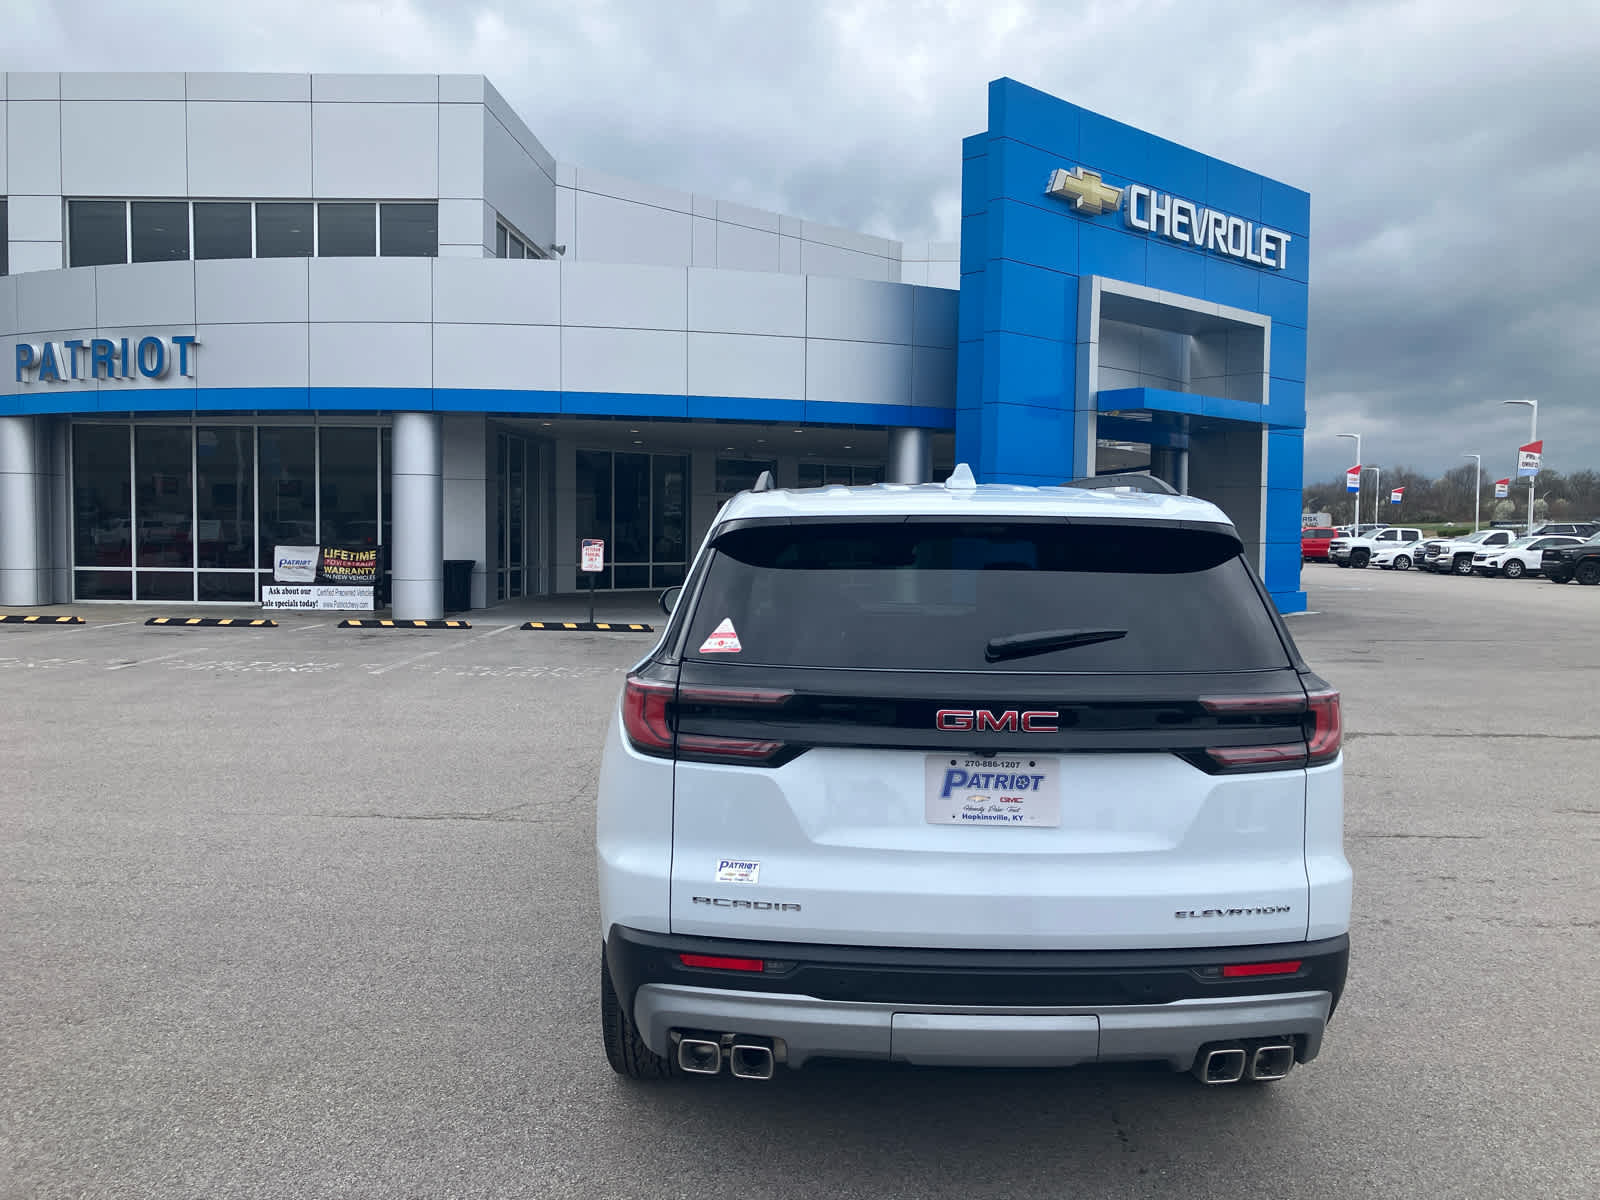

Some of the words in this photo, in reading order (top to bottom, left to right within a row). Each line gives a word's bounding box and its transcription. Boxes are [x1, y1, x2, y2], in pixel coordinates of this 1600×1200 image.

[1124, 184, 1292, 270] CHEVROLET
[16, 336, 201, 383] PATRIOT
[324, 548, 377, 561] LIFETIME
[279, 559, 312, 568] PATRIOT
[323, 566, 376, 575] WARRANTY
[269, 587, 281, 595] Ask
[282, 587, 299, 595] about
[275, 600, 298, 608] specials
[936, 709, 1060, 733] GMC
[964, 760, 1021, 769] 270-886-1207
[941, 768, 1045, 799] PATRIOT
[962, 813, 1011, 821] Hopkinsville,
[718, 860, 758, 872] PATRIOT
[692, 896, 802, 912] ACADIA
[1174, 904, 1291, 919] ELEVATION
